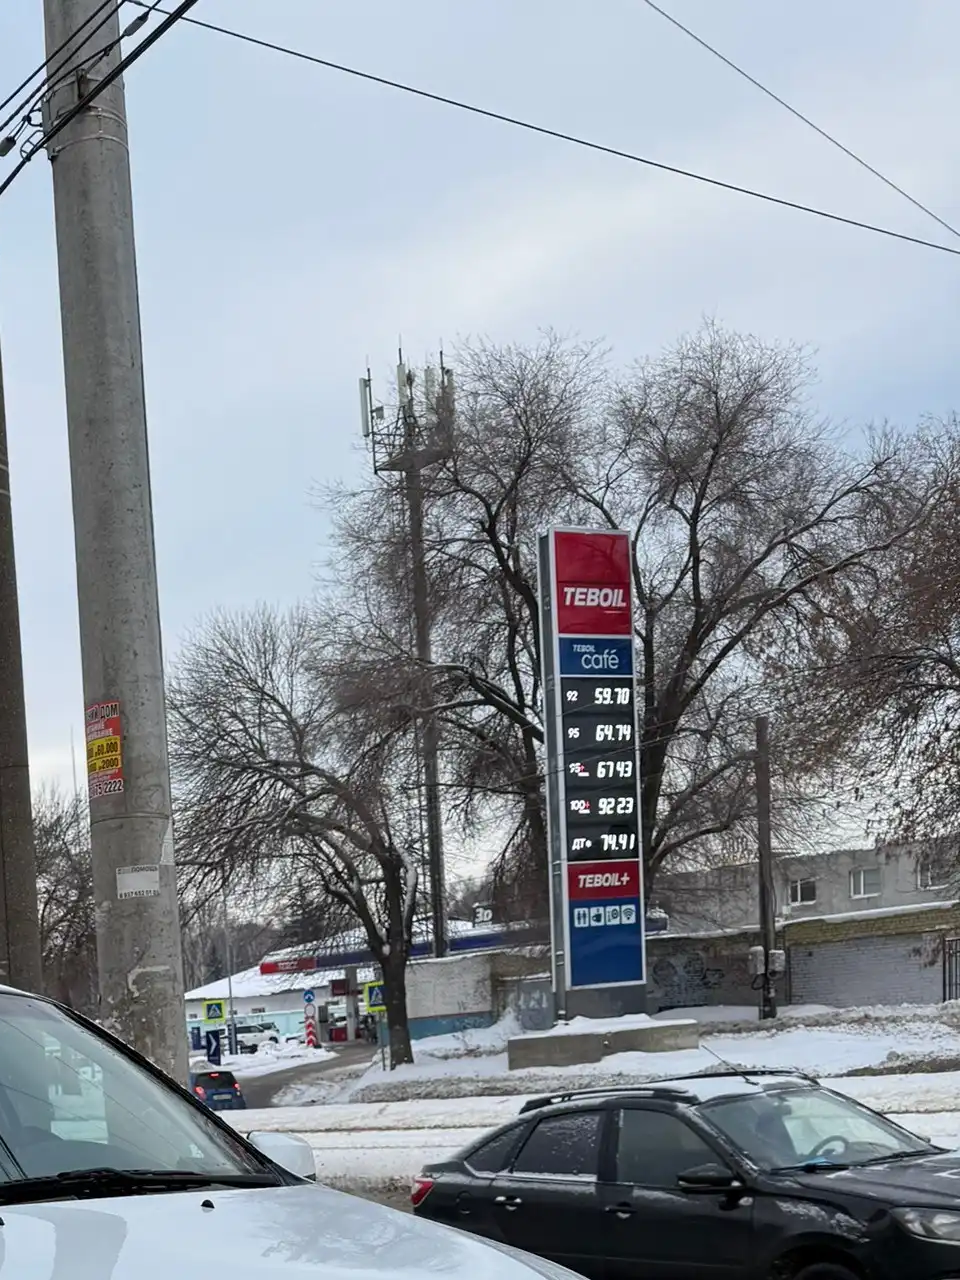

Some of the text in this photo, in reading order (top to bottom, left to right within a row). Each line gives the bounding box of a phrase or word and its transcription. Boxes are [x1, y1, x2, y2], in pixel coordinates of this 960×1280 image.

[563, 587, 627, 608] TEBOIL
[572, 644, 596, 652] TEBOIL
[581, 649, 620, 669] café
[566, 687, 630, 704] 92 59.70
[100, 703, 119, 719] ДОМ
[568, 724, 631, 742] 95 64.74
[104, 780, 123, 794] 2222
[600, 834, 635, 851] 74.41
[578, 872, 630, 888] TEBOIL+
